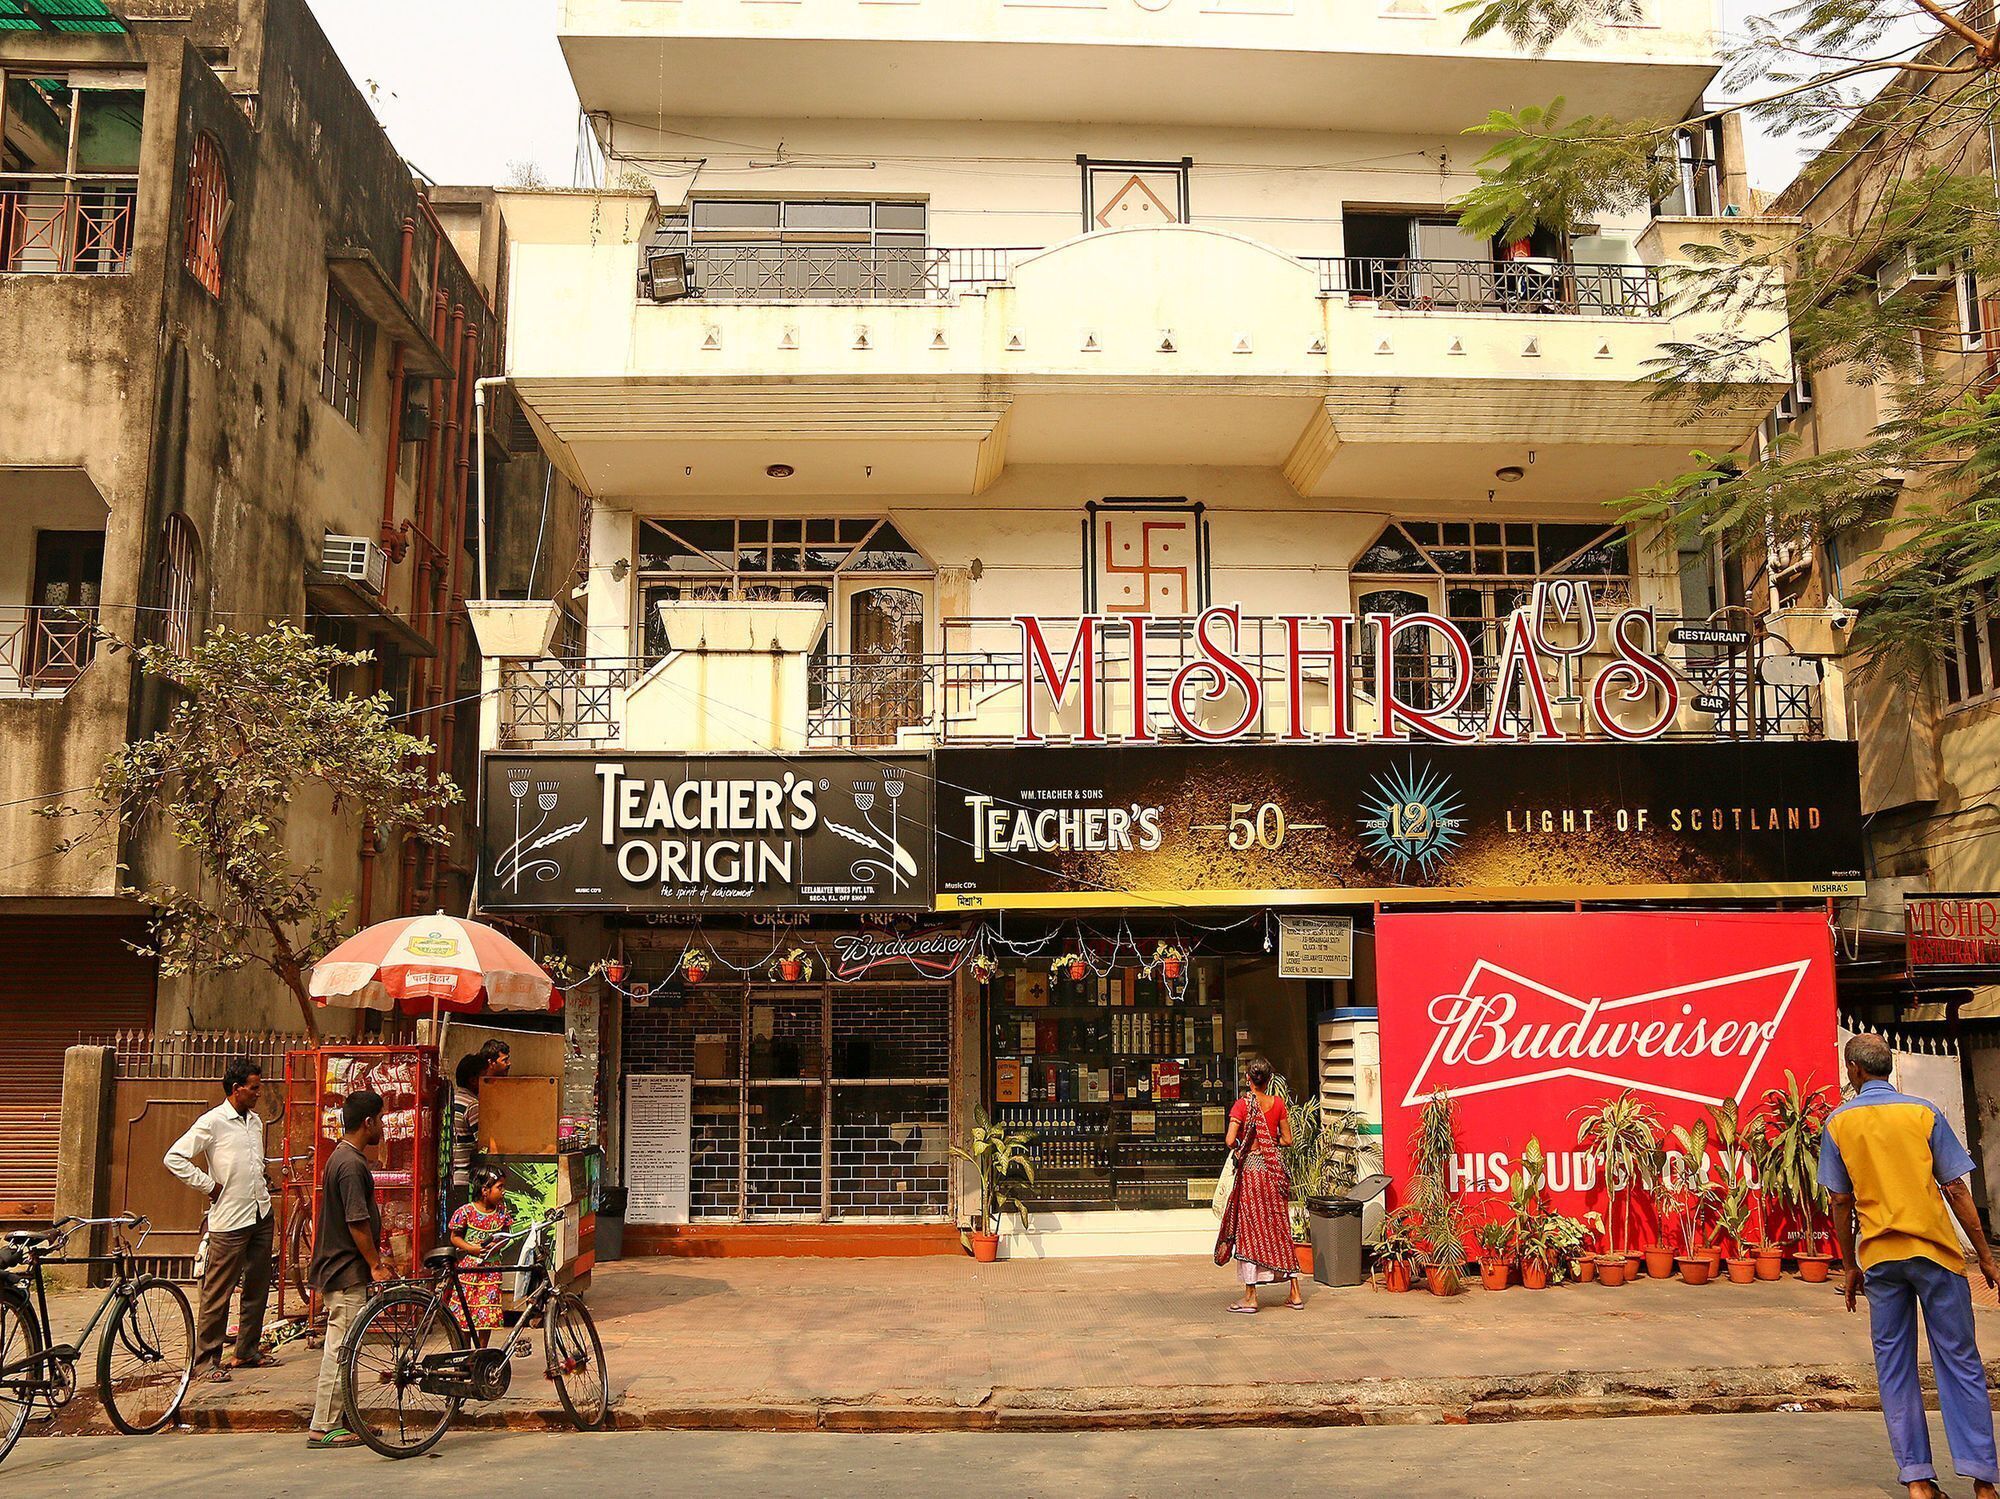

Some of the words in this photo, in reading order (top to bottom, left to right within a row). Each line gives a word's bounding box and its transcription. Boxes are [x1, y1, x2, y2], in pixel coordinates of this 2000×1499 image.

[1677, 629, 1748, 644] RESTAURANT
[1699, 696, 1724, 710] BAR
[594, 762, 818, 845] TEACHER'S
[1074, 789, 1081, 800] &
[1082, 789, 1103, 799] SONS
[964, 795, 1163, 863] TEACHER'S
[1228, 802, 1286, 851] 50
[1366, 820, 1389, 829] AGED
[1386, 802, 1429, 840] 12
[1430, 819, 1460, 828] YEARS
[1506, 809, 1595, 833] LIGHT
[1616, 808, 1649, 832] OF
[1671, 806, 1821, 832] SCOTLAND
[616, 839, 793, 884] ORIGIN
[660, 884, 673, 897] the
[675, 885, 698, 899] spirit
[700, 885, 709, 903] of
[711, 886, 755, 898] achievement
[1812, 884, 1849, 893] MISHRA'S
[833, 933, 976, 963] Budweiser
[1427, 992, 1776, 1066] Budweiser
[1443, 1151, 1510, 1193] HIS
